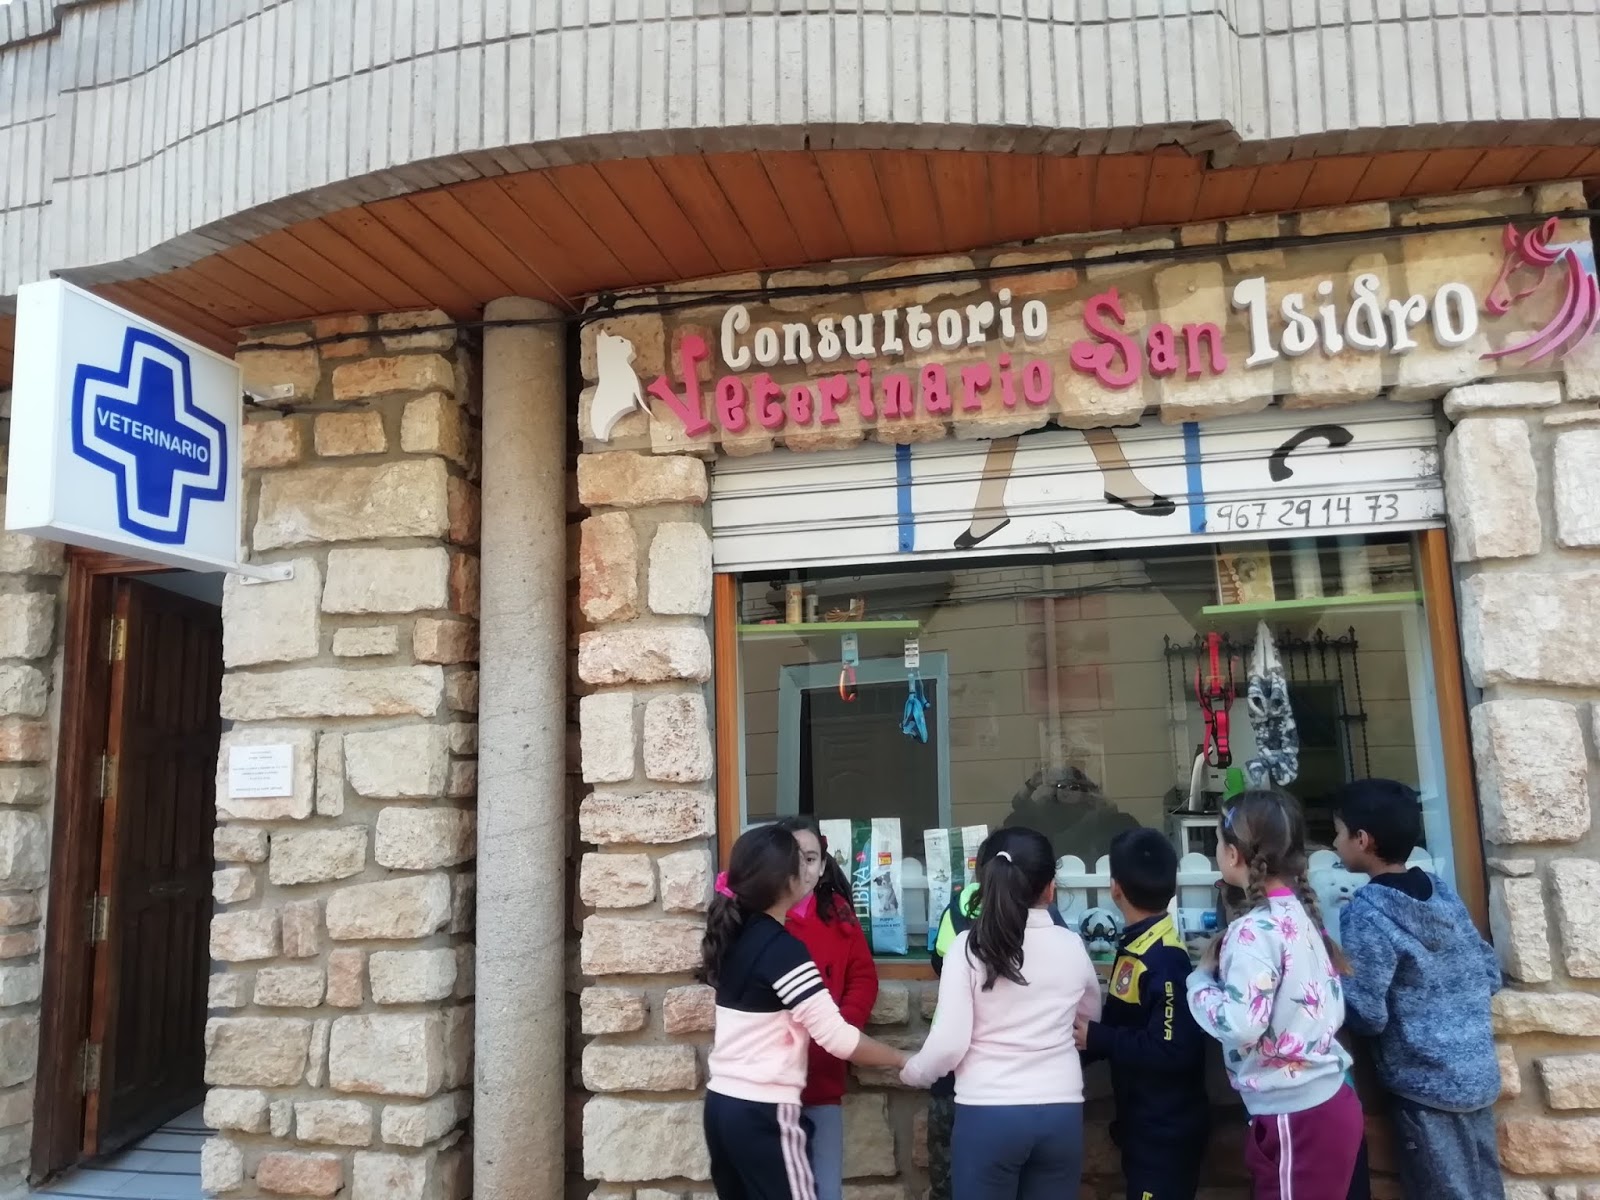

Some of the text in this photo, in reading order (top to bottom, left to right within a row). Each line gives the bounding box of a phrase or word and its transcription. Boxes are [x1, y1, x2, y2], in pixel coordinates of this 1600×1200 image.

[647, 273, 1479, 438] Veterinario San Isidro
[721, 287, 1049, 371] Consultorio
[97, 407, 208, 463] VETERINARIO
[1217, 493, 1400, 530] 967 29 14 73
[851, 865, 870, 918] LIBRA
[1164, 981, 1174, 1041] GIVOVA
